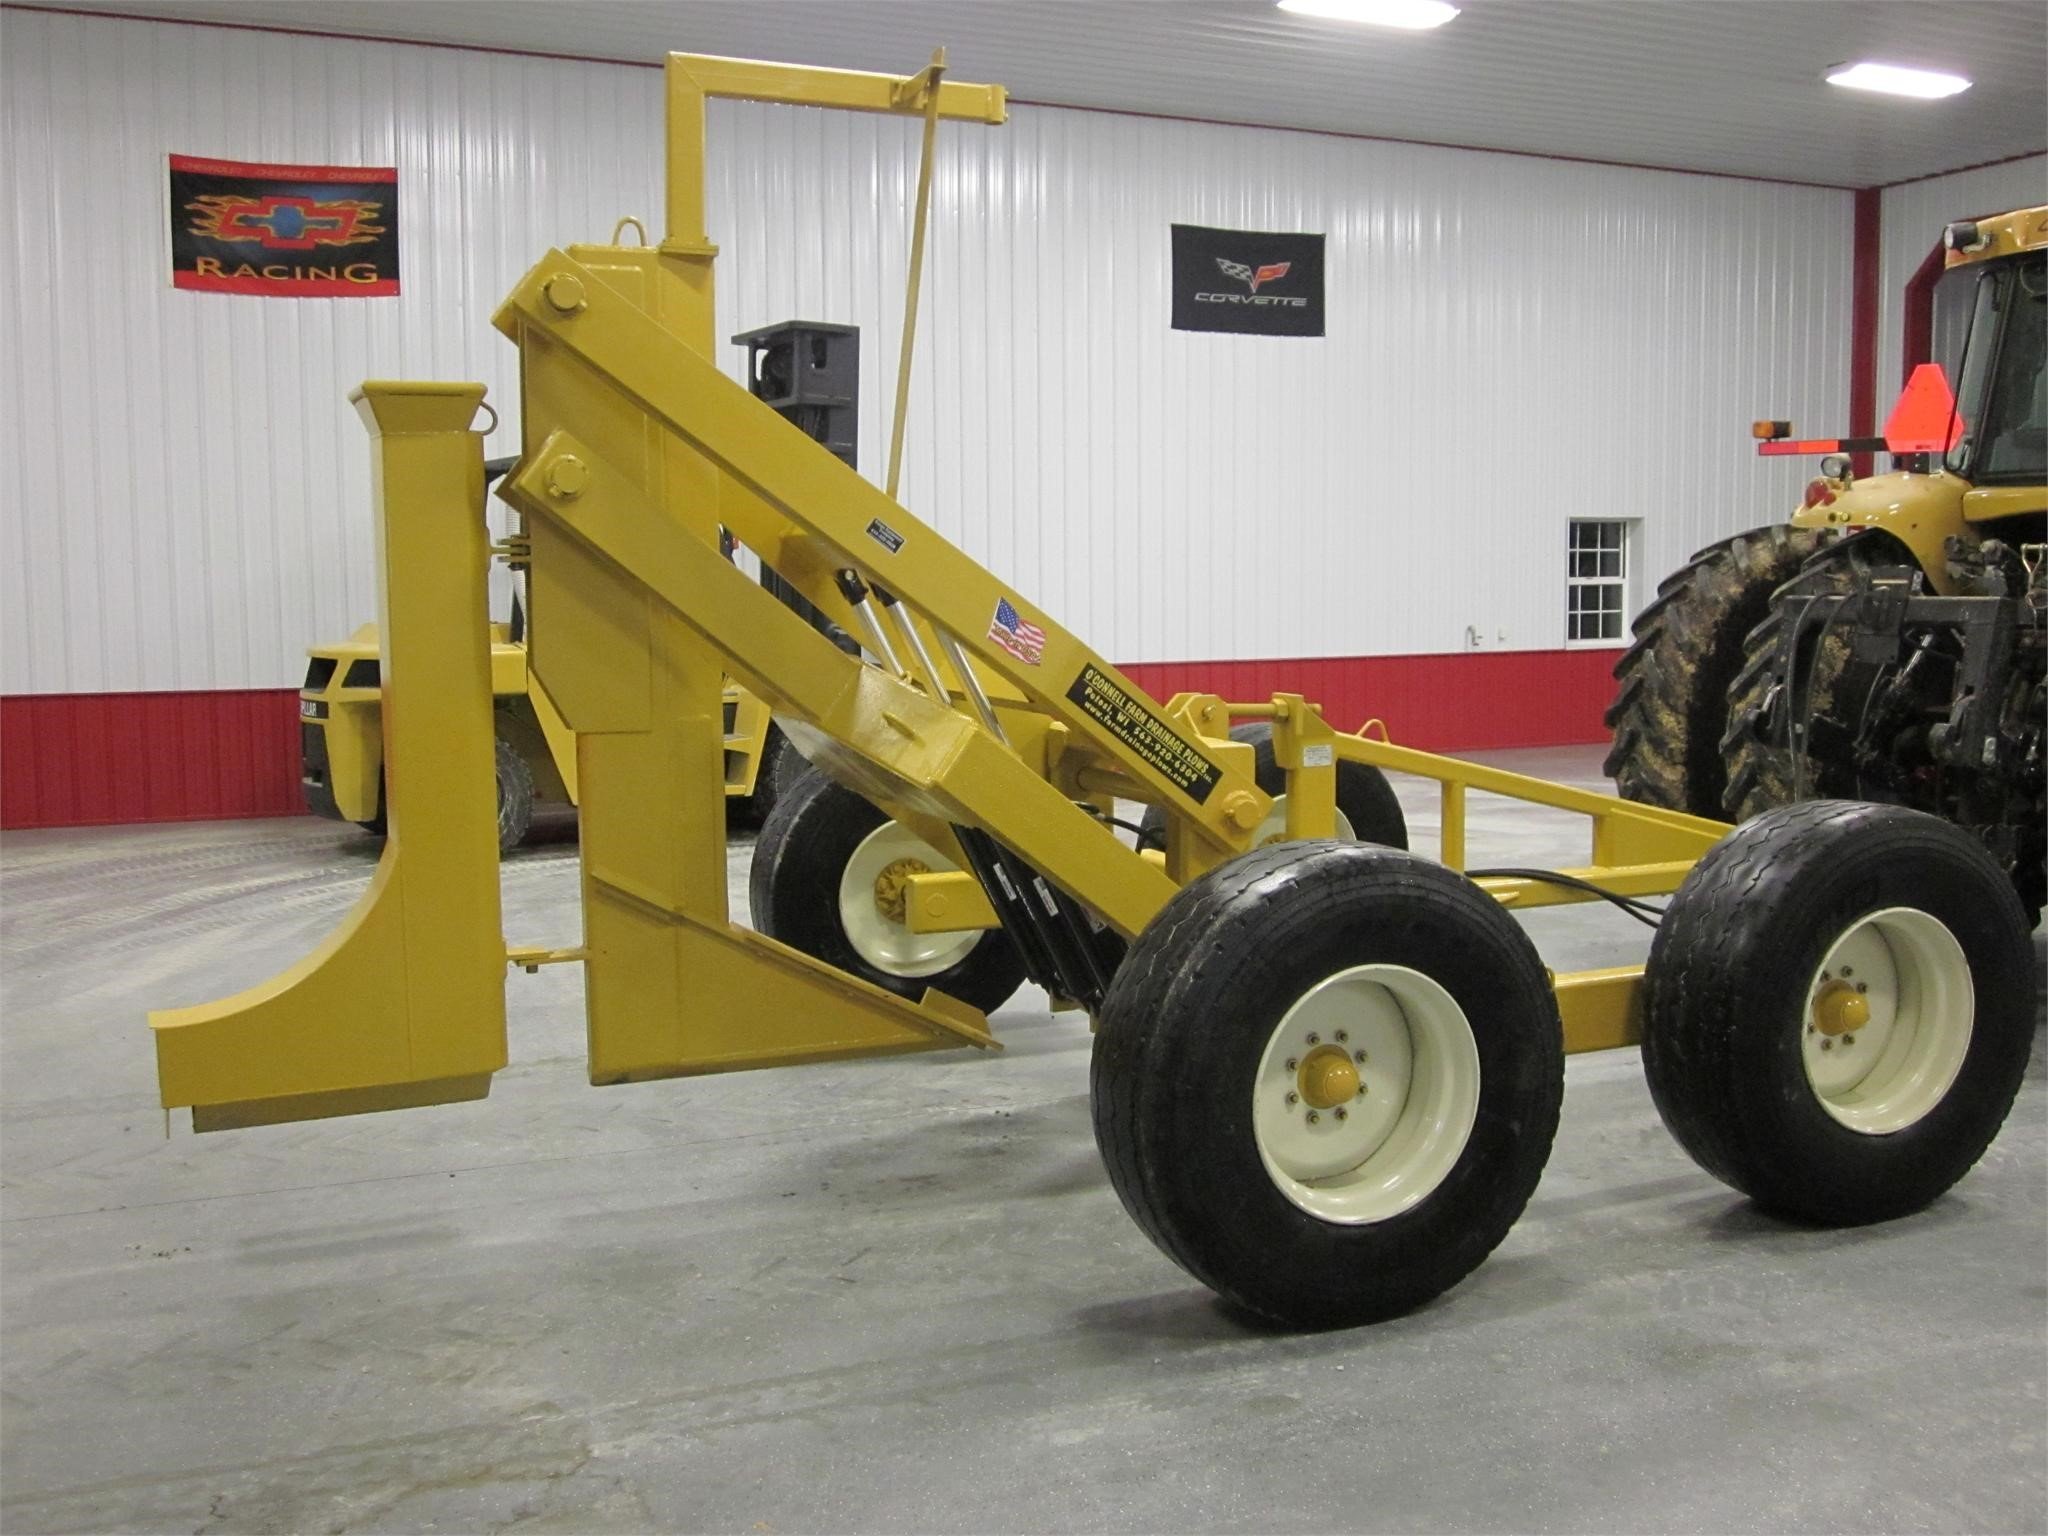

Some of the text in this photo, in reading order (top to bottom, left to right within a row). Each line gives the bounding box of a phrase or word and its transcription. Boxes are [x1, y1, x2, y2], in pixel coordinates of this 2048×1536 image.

[196, 256, 379, 284] RACING
[1194, 292, 1307, 306] CORVETTE
[1084, 687, 1113, 715] Potosi,
[1116, 714, 1131, 727] WI
[1085, 669, 1125, 707] O'CONNELL
[1124, 701, 1151, 725] FARM
[1147, 718, 1186, 755] DRAINAGE
